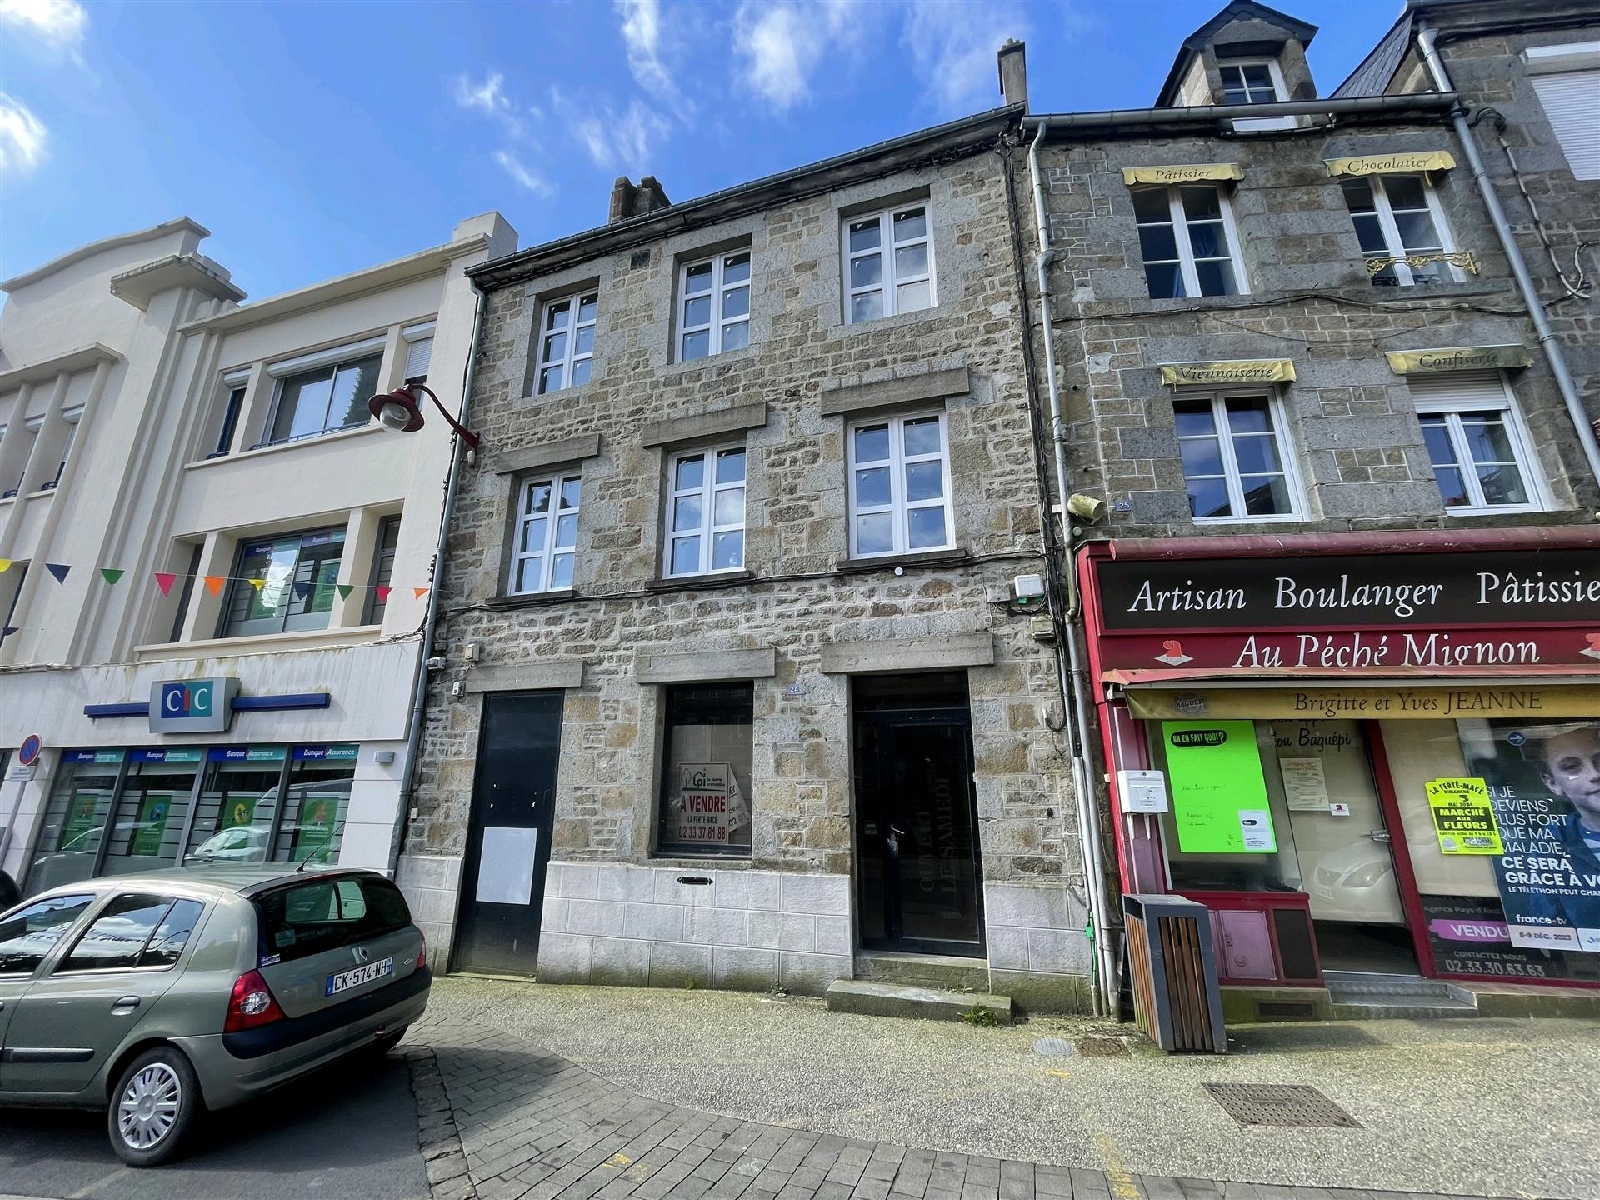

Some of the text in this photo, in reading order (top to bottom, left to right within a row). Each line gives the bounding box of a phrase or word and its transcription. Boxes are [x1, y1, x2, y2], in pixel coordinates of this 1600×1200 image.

[1347, 156, 1432, 172] Chocolatier
[1156, 169, 1213, 180] Pâtissier
[1420, 352, 1499, 369] Confiserie
[1180, 366, 1273, 380] Viennoiserie
[1127, 580, 1247, 612] Artisan
[1274, 574, 1443, 618] Boulanger
[1231, 631, 1541, 668] Au Péché Mignon
[166, 688, 207, 712] CIC
[1294, 691, 1542, 718] Brigitte et Yves JEANNE
[1500, 786, 1516, 798] JE
[689, 795, 726, 813] VENDRE
[1443, 821, 1488, 830] FLEURS
[1529, 814, 1567, 827] FORT
[1529, 828, 1556, 840] MA
[1502, 856, 1573, 871] CE SERA
[1505, 869, 1565, 886] GRÂCE
[1583, 874, 1600, 887] V
